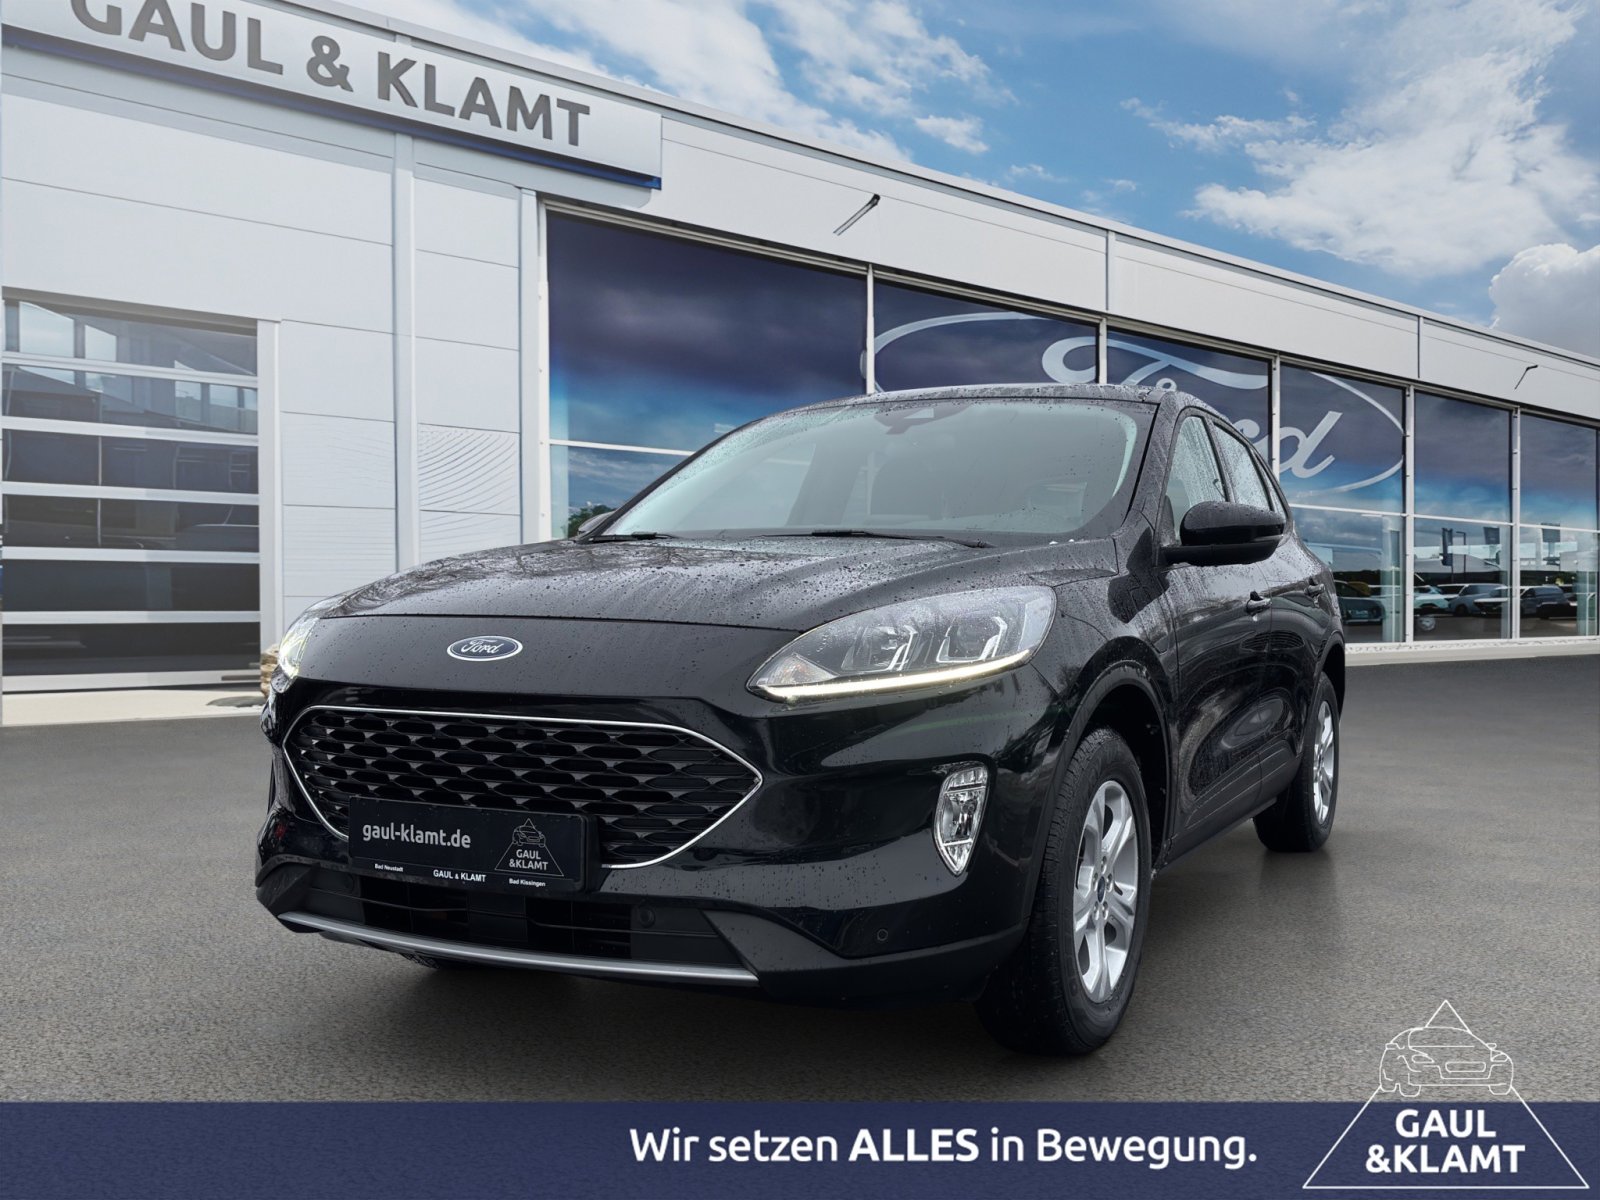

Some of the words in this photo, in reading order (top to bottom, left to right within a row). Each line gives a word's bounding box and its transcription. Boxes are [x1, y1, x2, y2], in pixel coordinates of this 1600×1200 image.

[306, 35, 354, 93] &
[377, 51, 590, 147] KLAMT
[460, 638, 505, 654] Ford
[362, 822, 471, 849] gaul-klamt.de
[516, 849, 542, 860] GAUL
[384, 864, 404, 873] Neustadt
[508, 858, 549, 871] &KLAMT
[433, 869, 454, 880] GAUL
[460, 872, 487, 883] KLAMT
[508, 877, 520, 885] Bad
[520, 879, 546, 888] Kissingen
